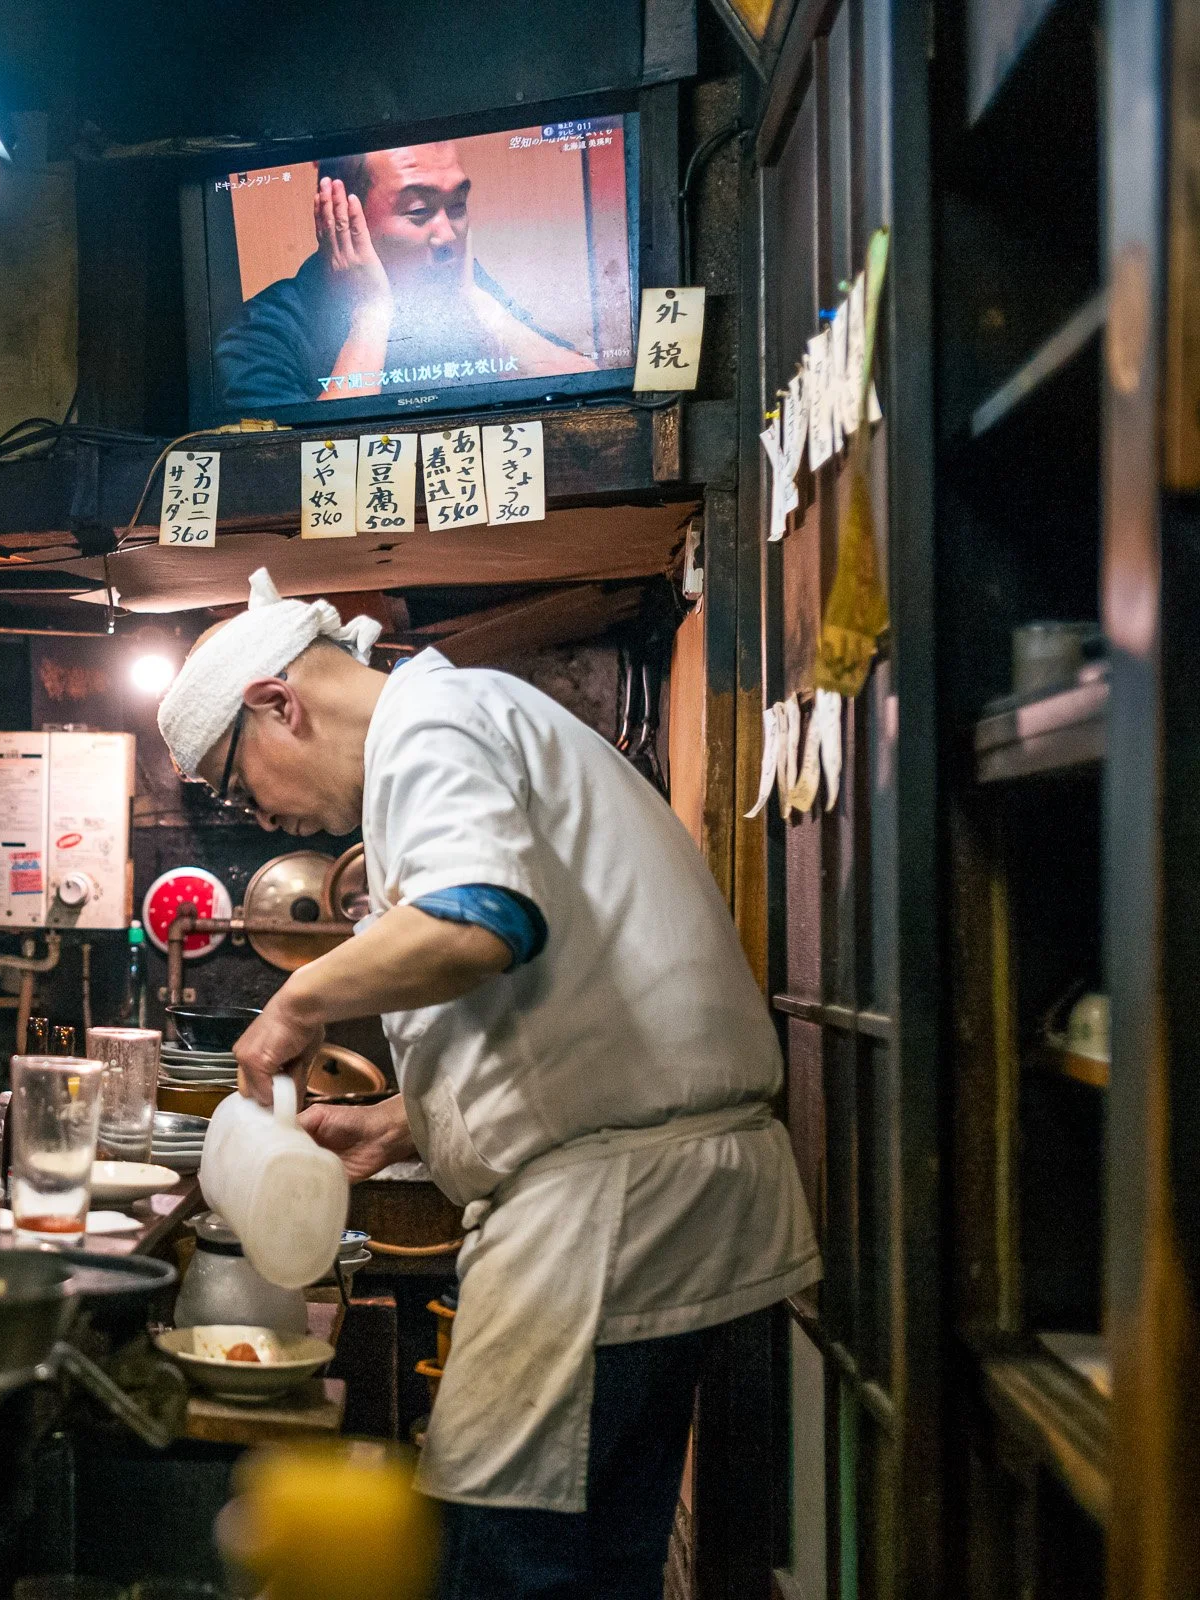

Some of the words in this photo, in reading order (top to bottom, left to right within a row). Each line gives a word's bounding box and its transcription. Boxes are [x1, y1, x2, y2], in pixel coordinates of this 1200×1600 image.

[577, 122, 592, 131] 011
[215, 174, 280, 192] ドキュメンタリー
[647, 300, 690, 369] 外税
[397, 395, 436, 406] SHARP
[309, 447, 339, 508] ひや奴
[365, 439, 402, 514] 肉豆腐
[425, 445, 456, 503] 煮込
[451, 430, 477, 502] あっさり
[501, 427, 533, 504] らっきょう
[165, 465, 189, 521] サラダ
[187, 456, 214, 521] マカロニ
[310, 510, 343, 528] 340
[365, 515, 406, 530] 500
[437, 502, 479, 525] 540
[496, 504, 530, 521] 340
[169, 525, 209, 543] 360
